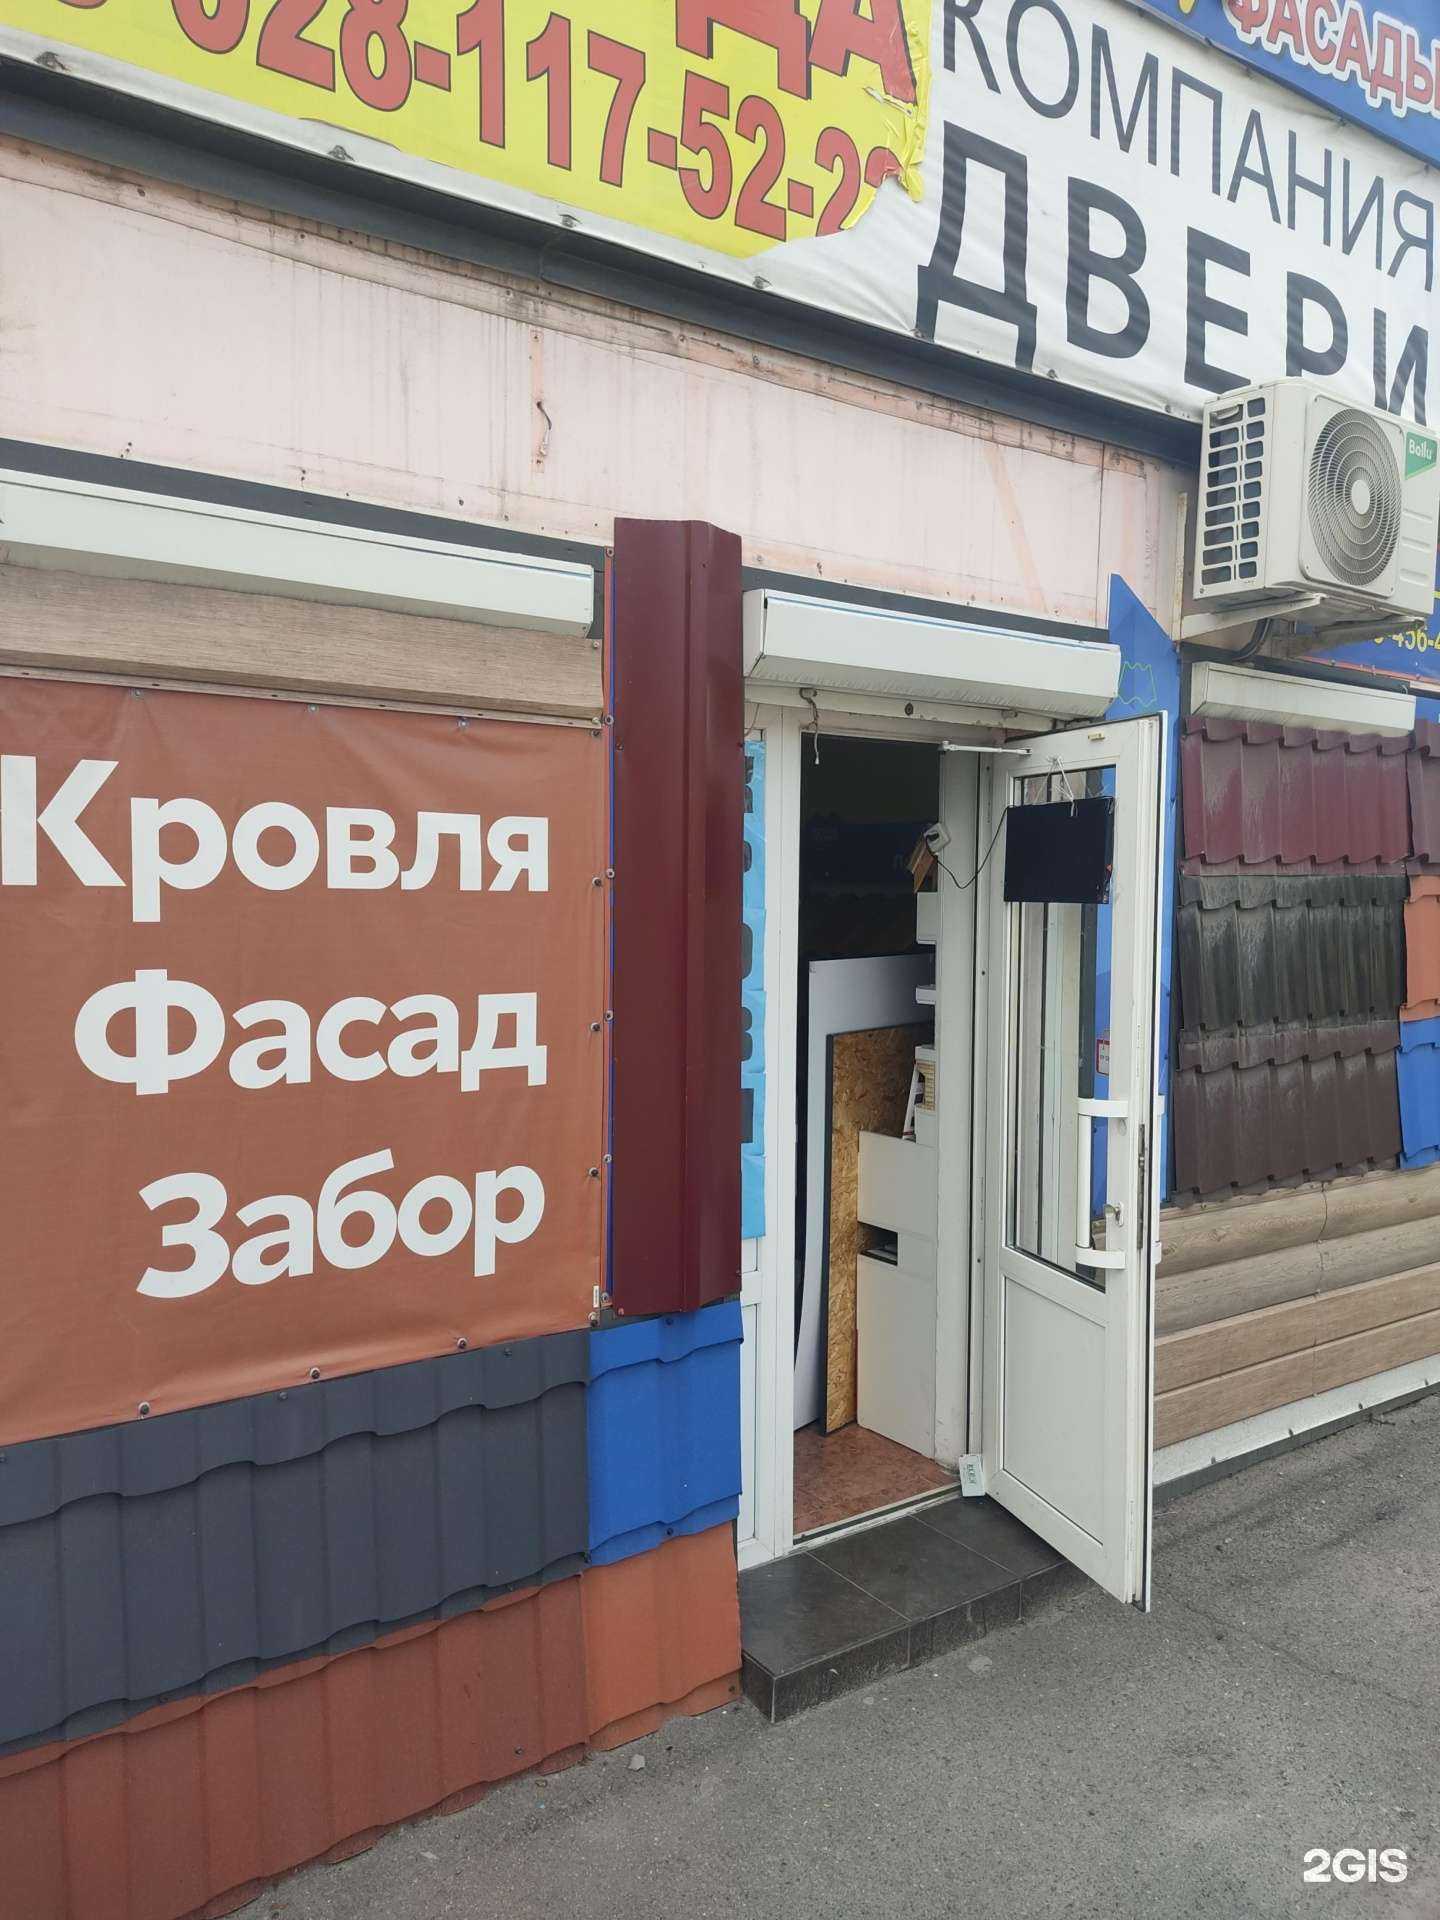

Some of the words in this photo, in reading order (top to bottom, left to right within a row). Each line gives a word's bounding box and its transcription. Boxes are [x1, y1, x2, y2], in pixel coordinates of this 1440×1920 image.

[915, 120, 1429, 425] ДВЕРИ
[0, 754, 549, 922] Кровля
[74, 969, 547, 1095] Фасад
[136, 1148, 545, 1298] Забор
